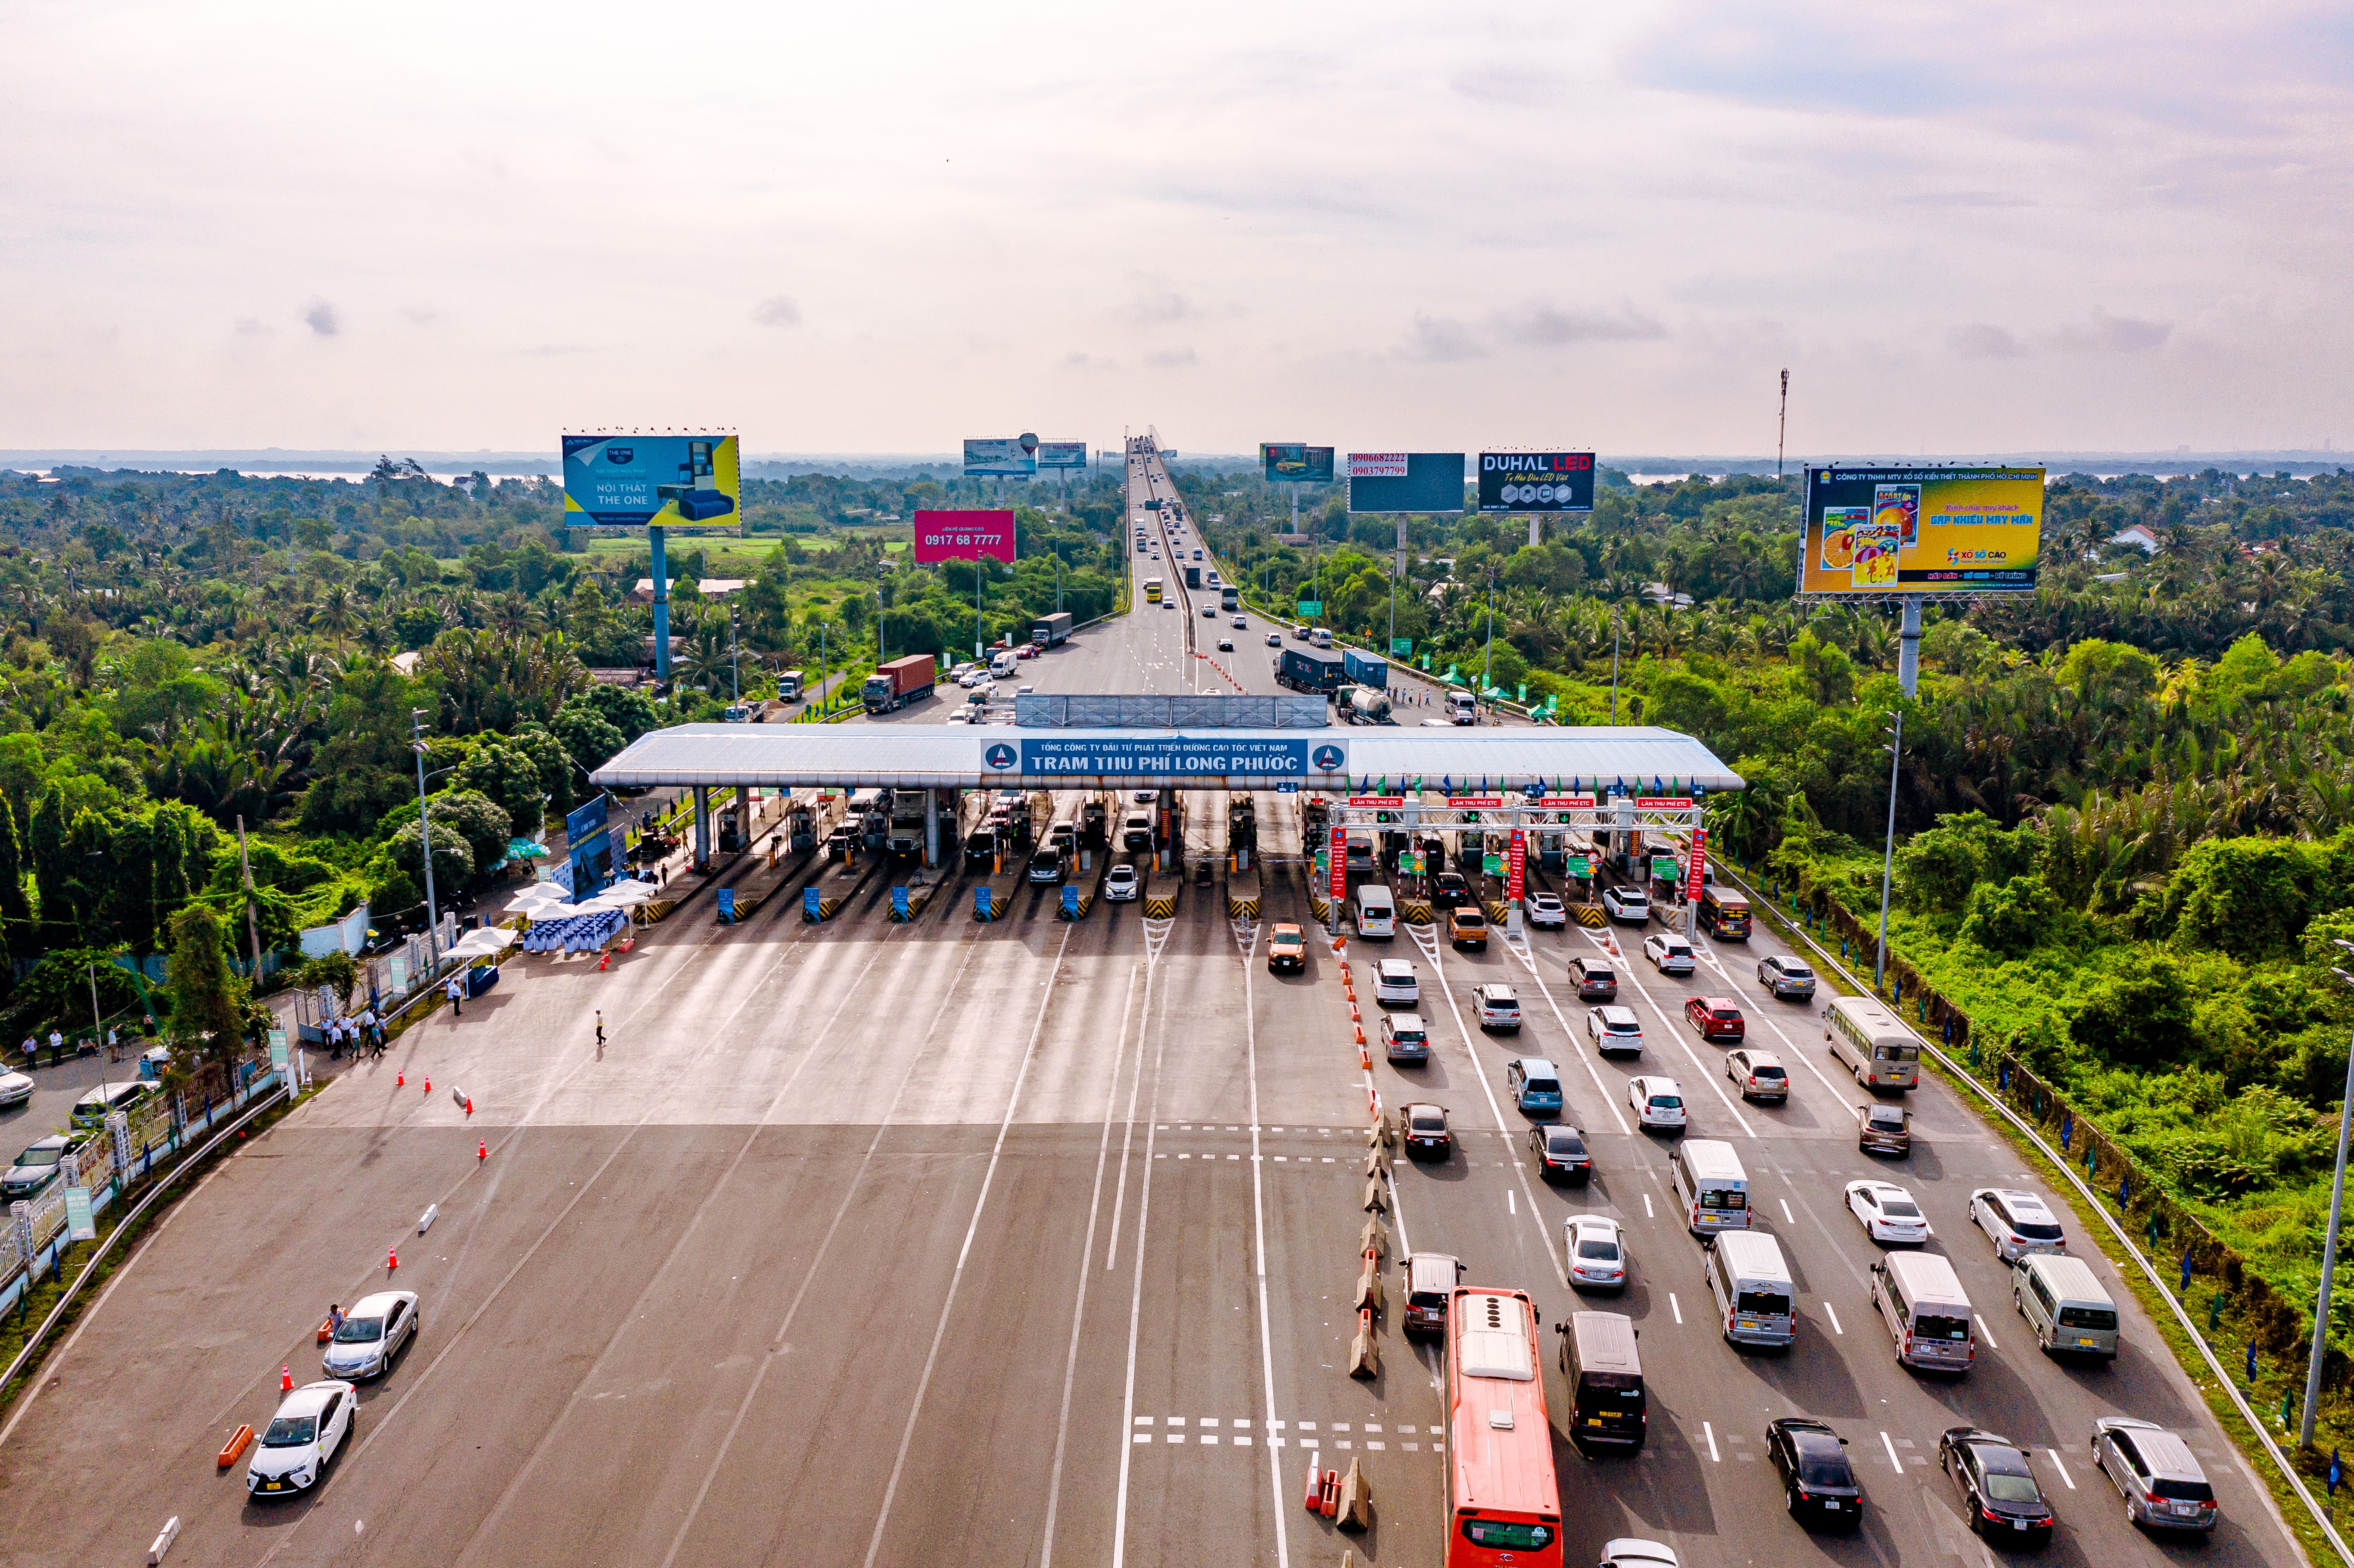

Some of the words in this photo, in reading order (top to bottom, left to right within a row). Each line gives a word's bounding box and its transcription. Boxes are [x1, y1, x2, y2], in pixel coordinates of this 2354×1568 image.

[1353, 453, 1405, 462] 0906682222
[1484, 456, 1548, 470] DUHAL
[1553, 456, 1590, 470] LED
[1353, 467, 1405, 475] 0903797799
[1903, 471, 1913, 480] XỔ
[1914, 472, 1924, 480] SỐ
[1924, 472, 1939, 480] KIẾN
[597, 482, 615, 495] NỘI
[619, 481, 646, 492] THẤT
[598, 496, 620, 504] THE
[624, 496, 648, 504] ONE
[1930, 514, 1951, 526] GẶP
[1952, 513, 1983, 525] NHIỀU
[1985, 515, 2008, 525] MAY
[2010, 513, 2033, 525] MẮN
[925, 535, 953, 545] 0917
[956, 535, 970, 545] 68
[974, 535, 1001, 545] 7777
[1961, 549, 1973, 558] XỔ
[1974, 549, 1987, 558] SỐ
[1988, 550, 2006, 558] CÀO
[1040, 741, 1062, 751] TỔNG
[1064, 742, 1087, 751] CÔNG
[1102, 742, 1118, 751] ĐẦU
[1158, 741, 1180, 751] TRIỂN
[1183, 743, 1210, 751] ĐƯỜNG
[1231, 742, 1247, 751] TỐC
[1249, 743, 1266, 753] VIỆT
[1031, 757, 1088, 773] TRẠM
[1095, 757, 1133, 770] THU
[1139, 753, 1172, 770] PHÍ
[1176, 756, 1226, 770] LONG
[1232, 753, 1298, 770] PHƯỚC
